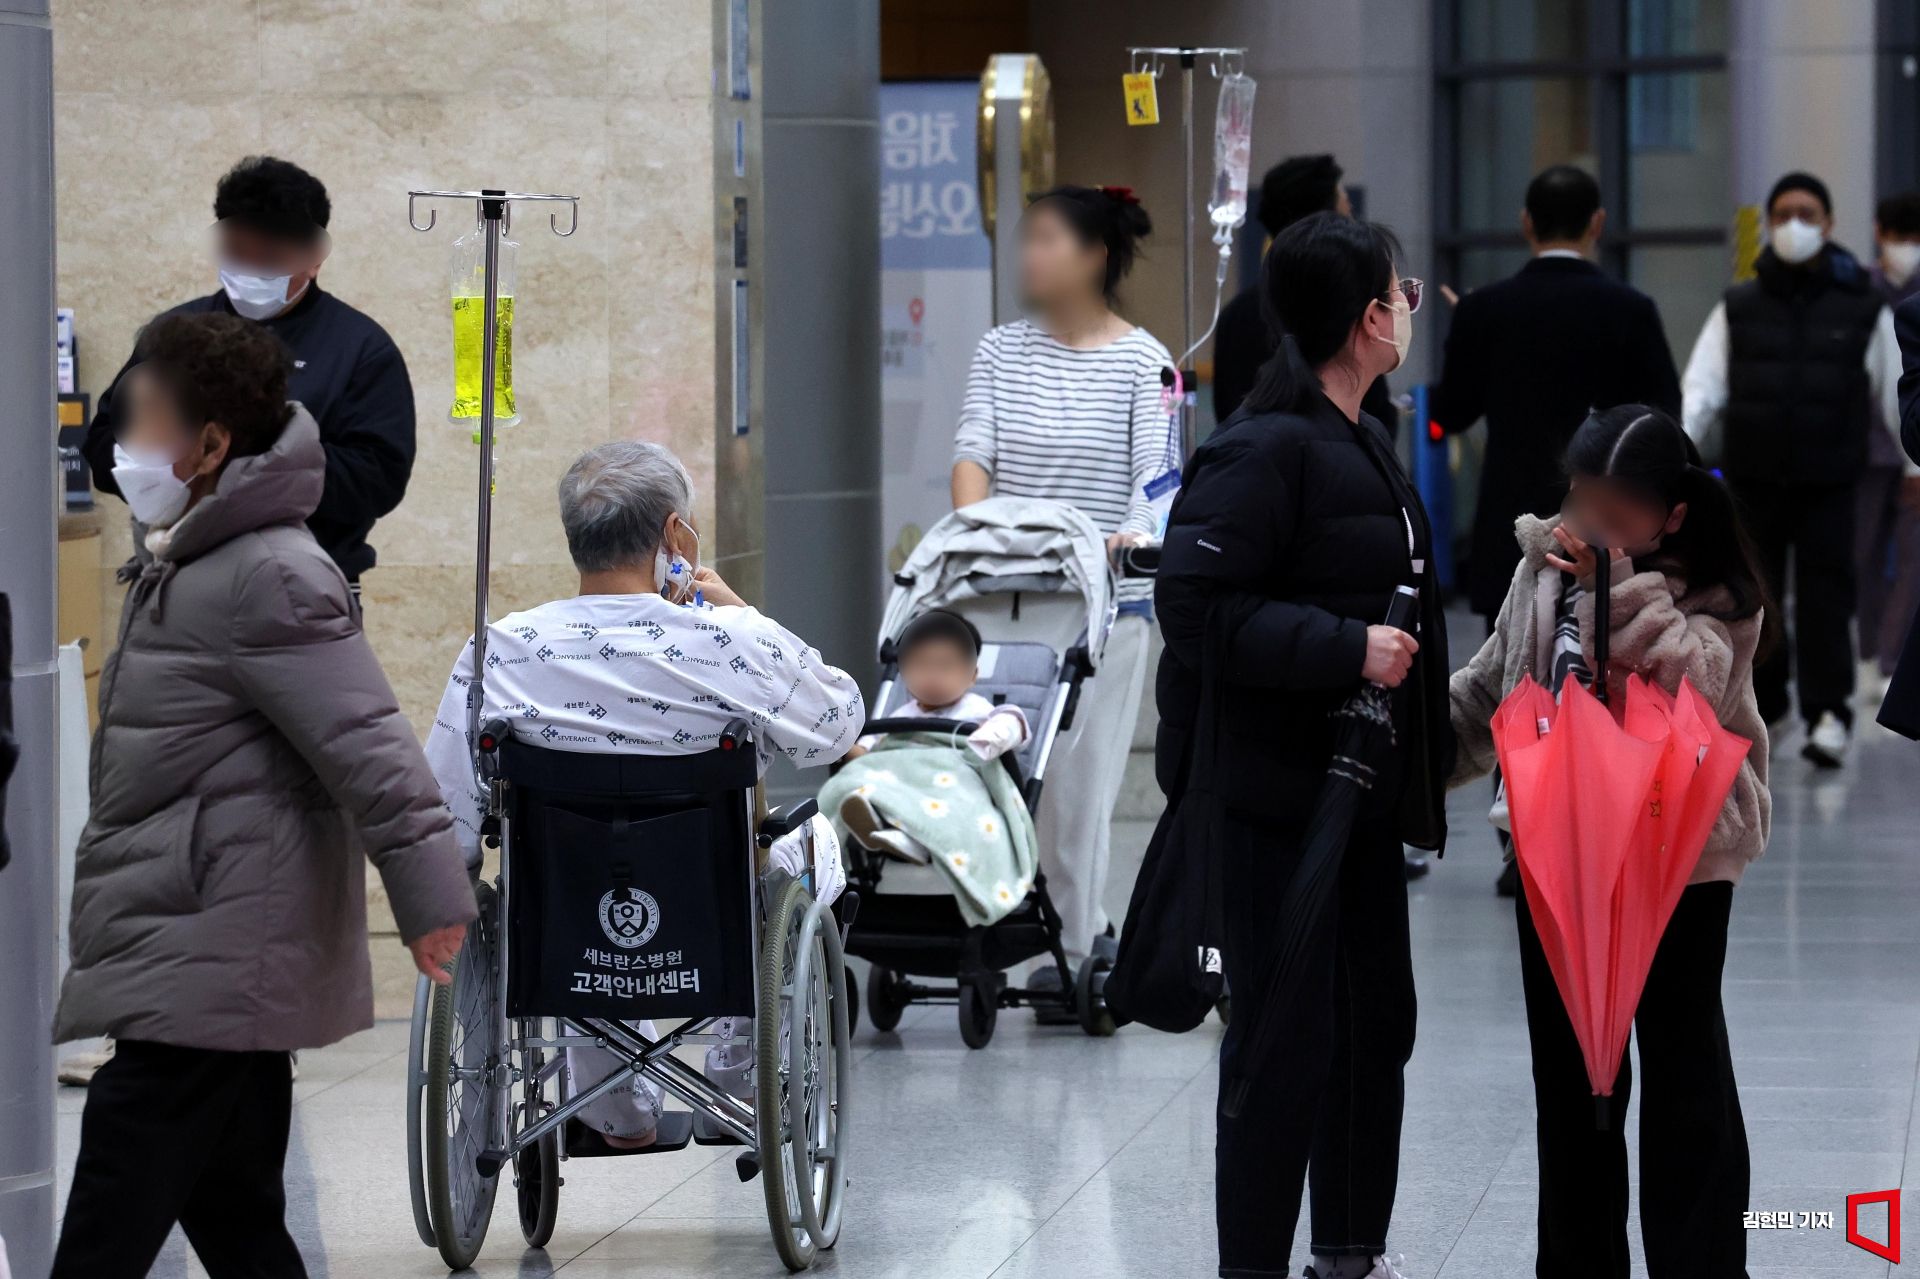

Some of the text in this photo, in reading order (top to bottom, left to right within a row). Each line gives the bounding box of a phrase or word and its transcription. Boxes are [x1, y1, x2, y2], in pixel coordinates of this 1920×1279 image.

[499, 656, 530, 667] SEVERANCE
[551, 653, 591, 661] SEVERANCE
[680, 656, 721, 668] SEVERANCE
[452, 673, 469, 687] 세브란
[564, 701, 591, 710] 세브란스
[557, 735, 597, 744] SEVERANCE
[582, 948, 682, 971] 세브란스병원
[570, 968, 700, 998] 고객안내센터
